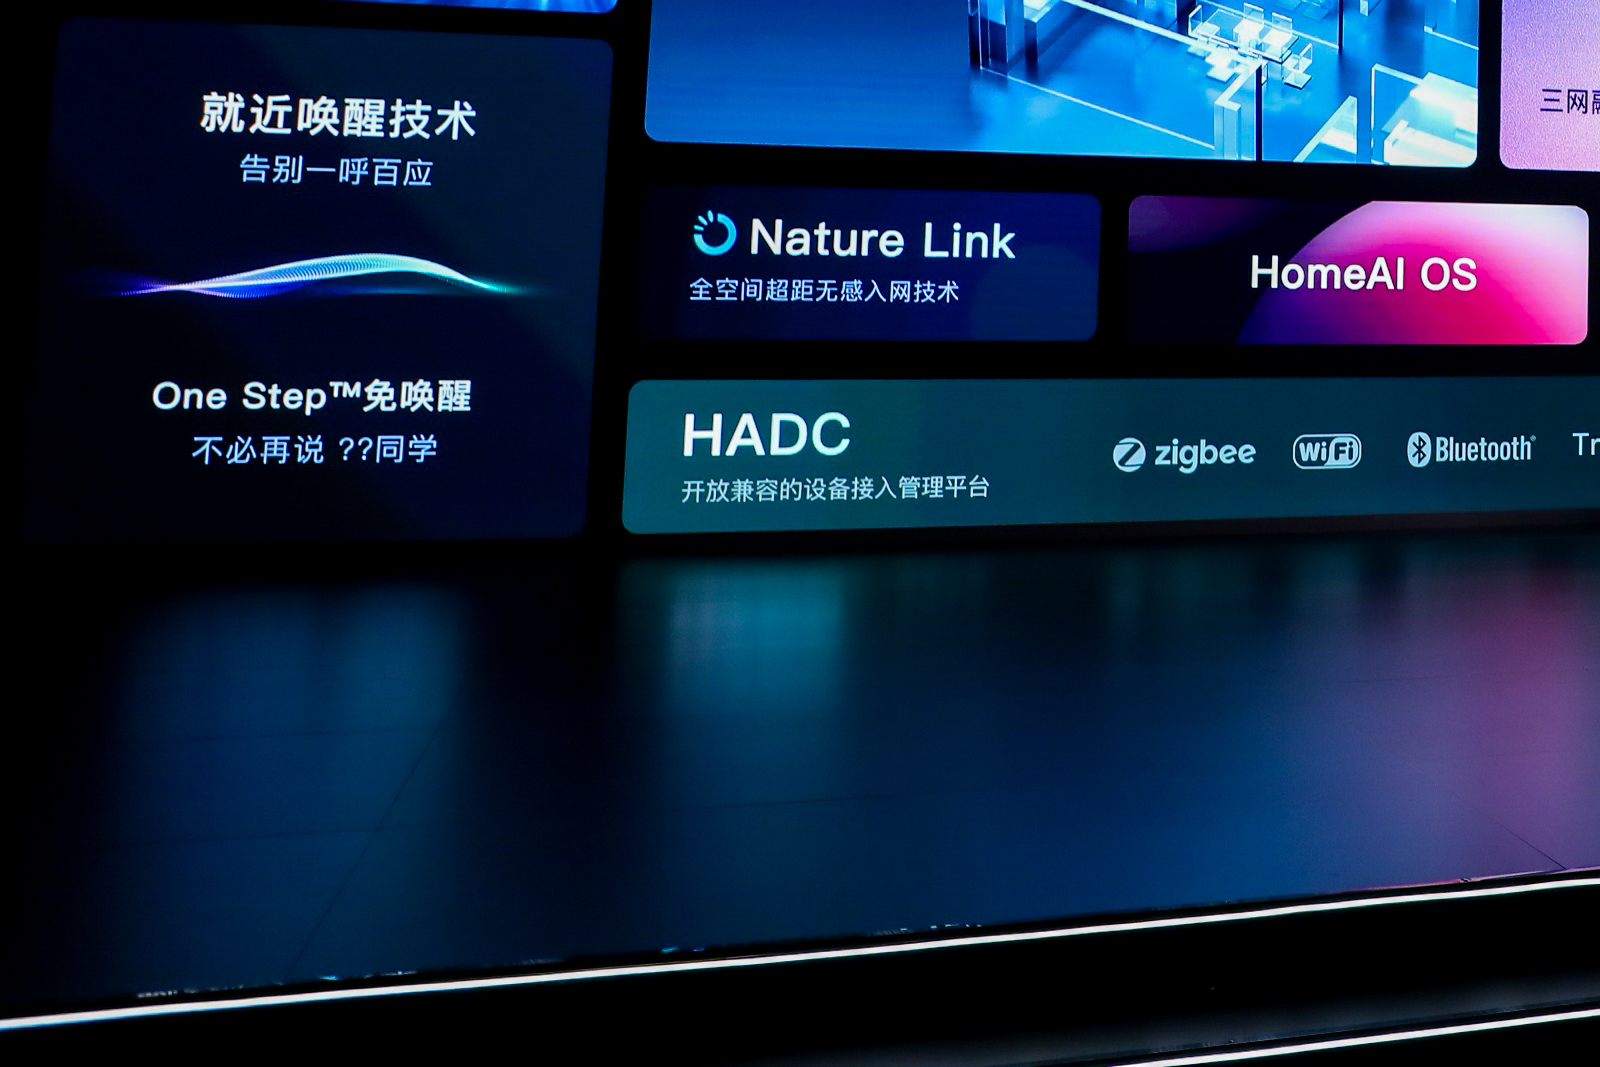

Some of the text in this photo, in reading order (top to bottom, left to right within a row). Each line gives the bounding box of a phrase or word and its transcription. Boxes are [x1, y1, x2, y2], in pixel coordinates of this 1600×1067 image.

[200, 92, 476, 140] 就近唤醒技术
[240, 154, 433, 186] 告别一呼百应
[751, 219, 1015, 258] Nature Link
[1250, 254, 1479, 292] HomeAI OS
[690, 278, 959, 303] 全空间超距无感入网技术
[153, 382, 227, 409] One
[192, 435, 324, 464] 不必再说
[684, 412, 850, 456] HADC
[1155, 438, 1256, 473] zigbee
[681, 474, 991, 505] 开放兼容的设备接入管理平台
